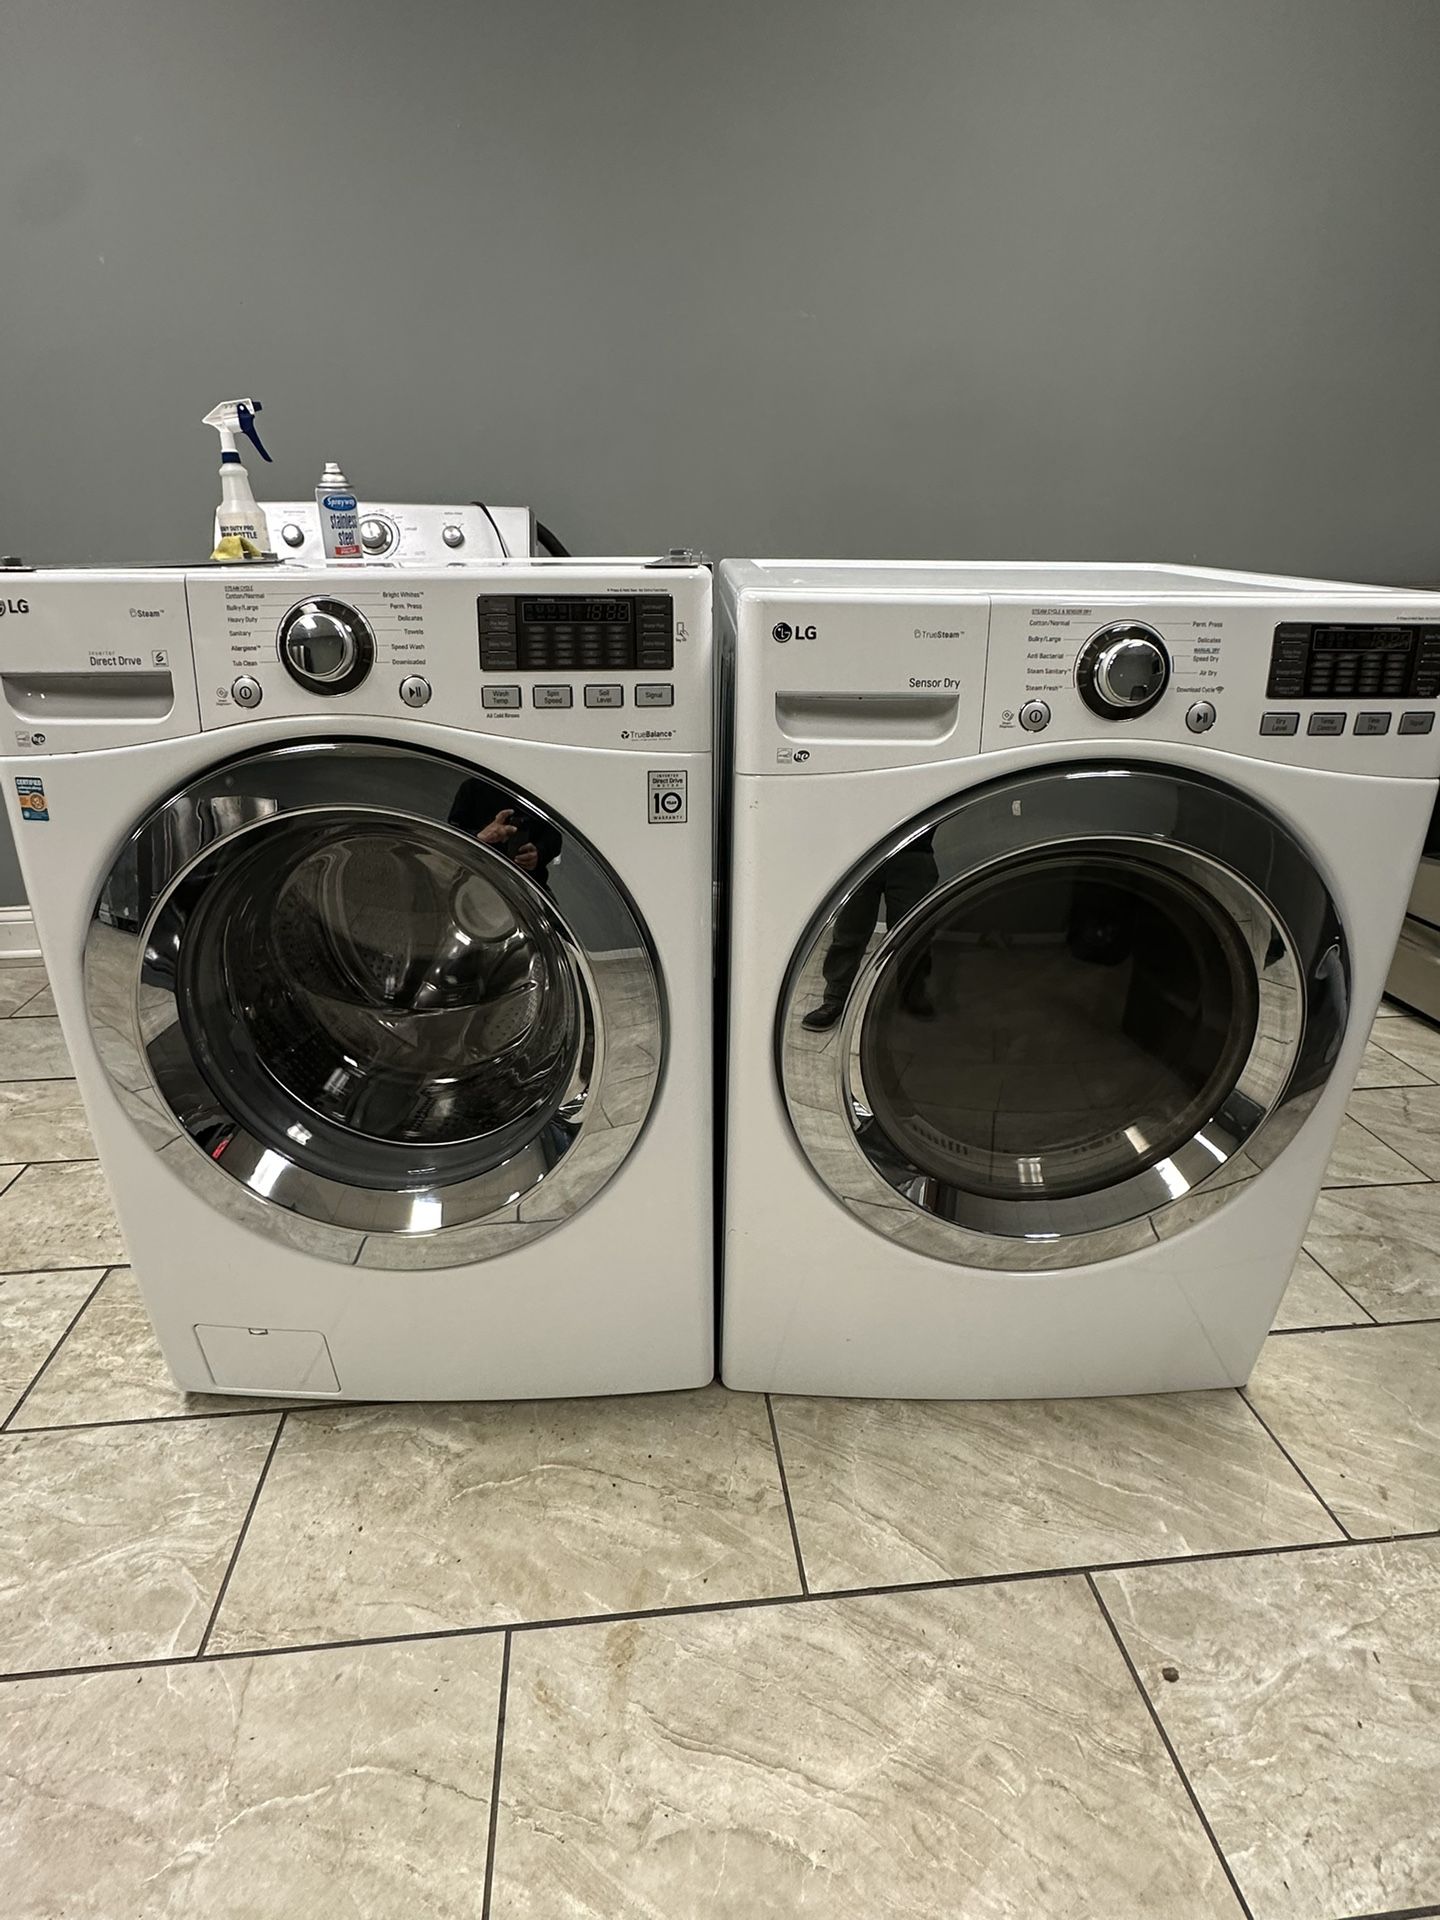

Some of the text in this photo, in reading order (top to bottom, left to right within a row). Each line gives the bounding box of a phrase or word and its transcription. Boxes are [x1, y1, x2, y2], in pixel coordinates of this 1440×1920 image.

[330, 513, 358, 530] stainless
[338, 530, 355, 546] steel
[382, 592, 400, 600] Bright
[8, 599, 30, 614] LG
[795, 626, 817, 640] LG
[90, 656, 117, 666] Direct
[118, 656, 142, 666] Drive
[909, 678, 960, 690] Sensor Dry
[654, 792, 682, 813] 10
